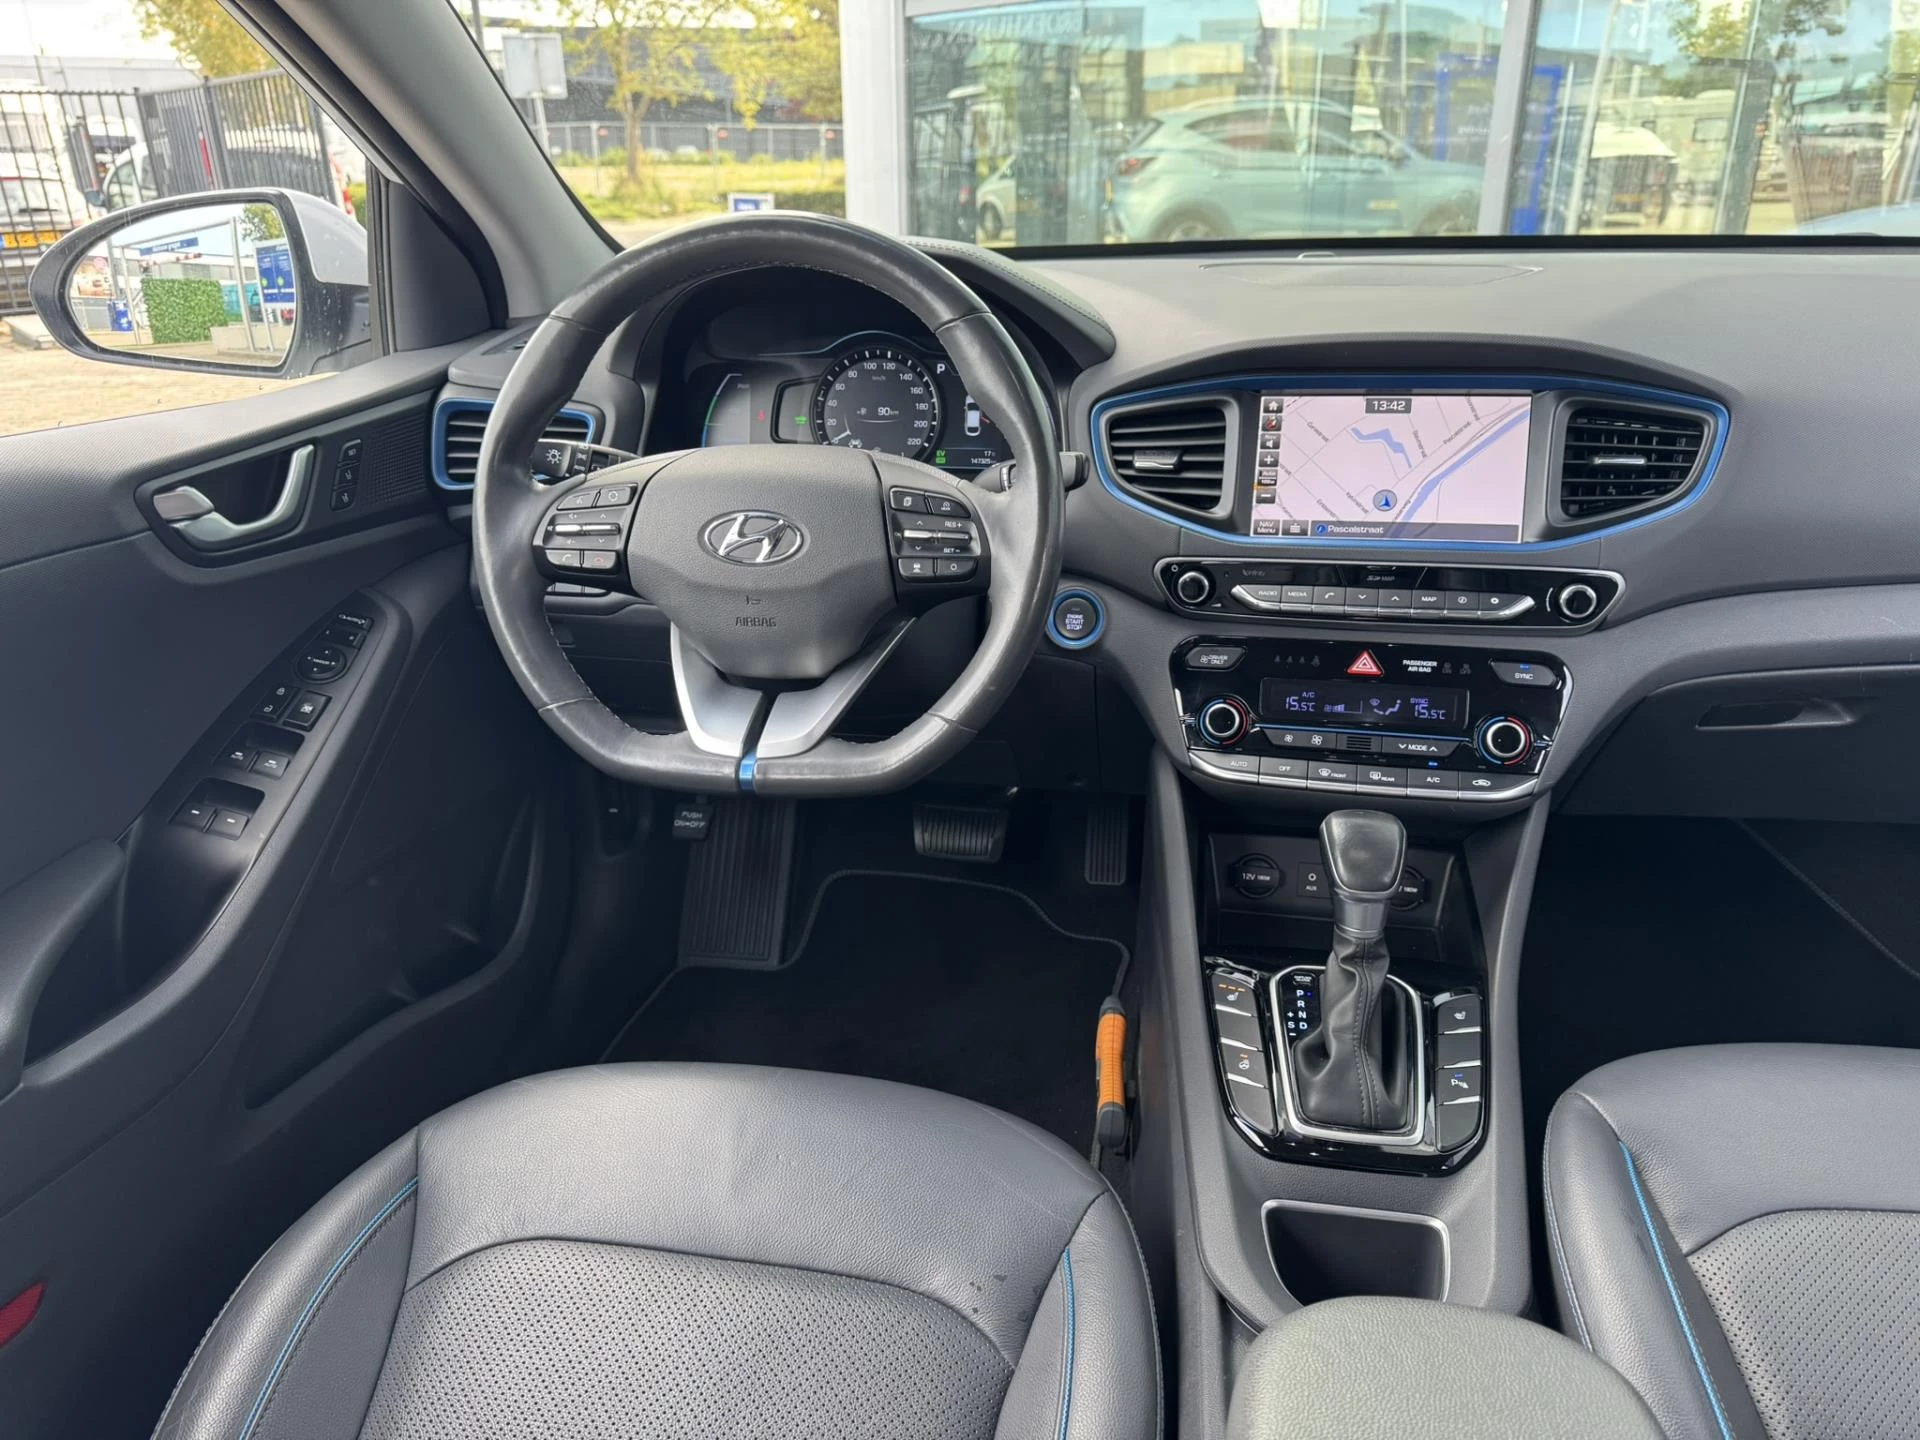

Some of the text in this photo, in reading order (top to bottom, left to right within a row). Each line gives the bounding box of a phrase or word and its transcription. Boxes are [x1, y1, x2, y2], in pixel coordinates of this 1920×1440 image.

[863, 362, 877, 370] 100
[882, 362, 896, 370] 120
[936, 363, 946, 374] P
[899, 373, 913, 381] 140
[835, 383, 845, 391] 60
[910, 387, 924, 395] 160
[1372, 400, 1406, 411] 13:42
[735, 616, 777, 627] AIRBAG
[1514, 672, 1534, 680] SYNC
[1242, 872, 1256, 880] 12V
[1288, 1021, 1308, 1030] S D
